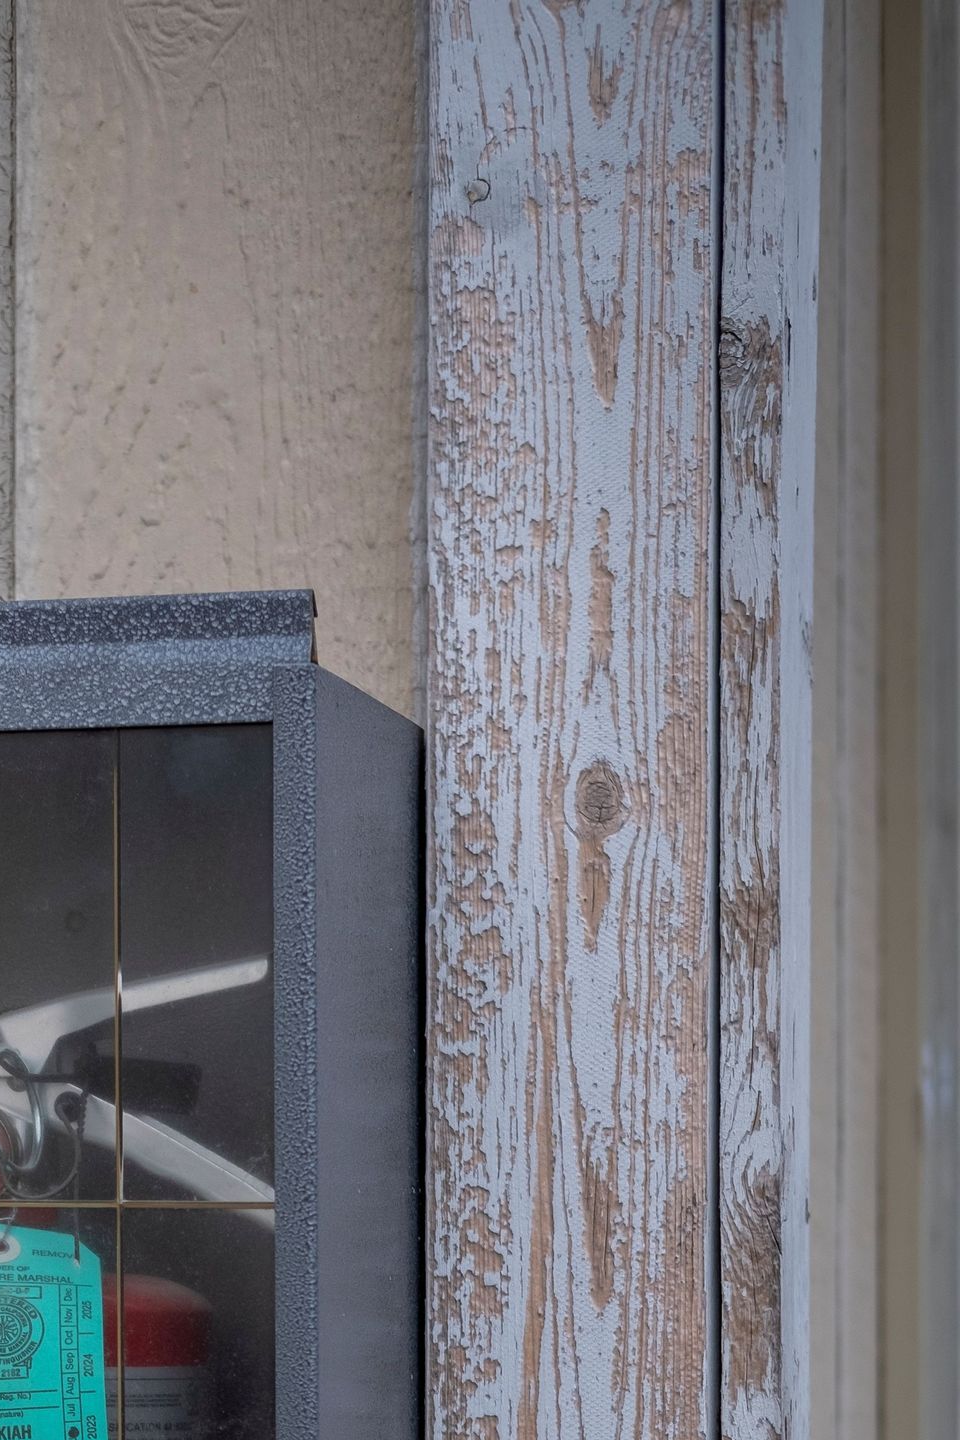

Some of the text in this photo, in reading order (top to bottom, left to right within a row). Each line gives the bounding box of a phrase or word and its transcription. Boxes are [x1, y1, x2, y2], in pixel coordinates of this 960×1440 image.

[31, 1249, 74, 1259] REMOV
[18, 1274, 74, 1284] MARSHAL
[64, 1288, 73, 1302] Dec
[64, 1308, 73, 1323] Nov
[82, 1300, 92, 1320] 2025
[65, 1330, 73, 1345] Oct
[66, 1352, 74, 1370] Sep
[84, 1354, 93, 1377] 2024
[66, 1376, 74, 1394] Aug
[0, 1394, 14, 1402] Reg.
[15, 1393, 32, 1401] No.)
[67, 1404, 75, 1416] Jul
[87, 1415, 97, 1439] 2023
